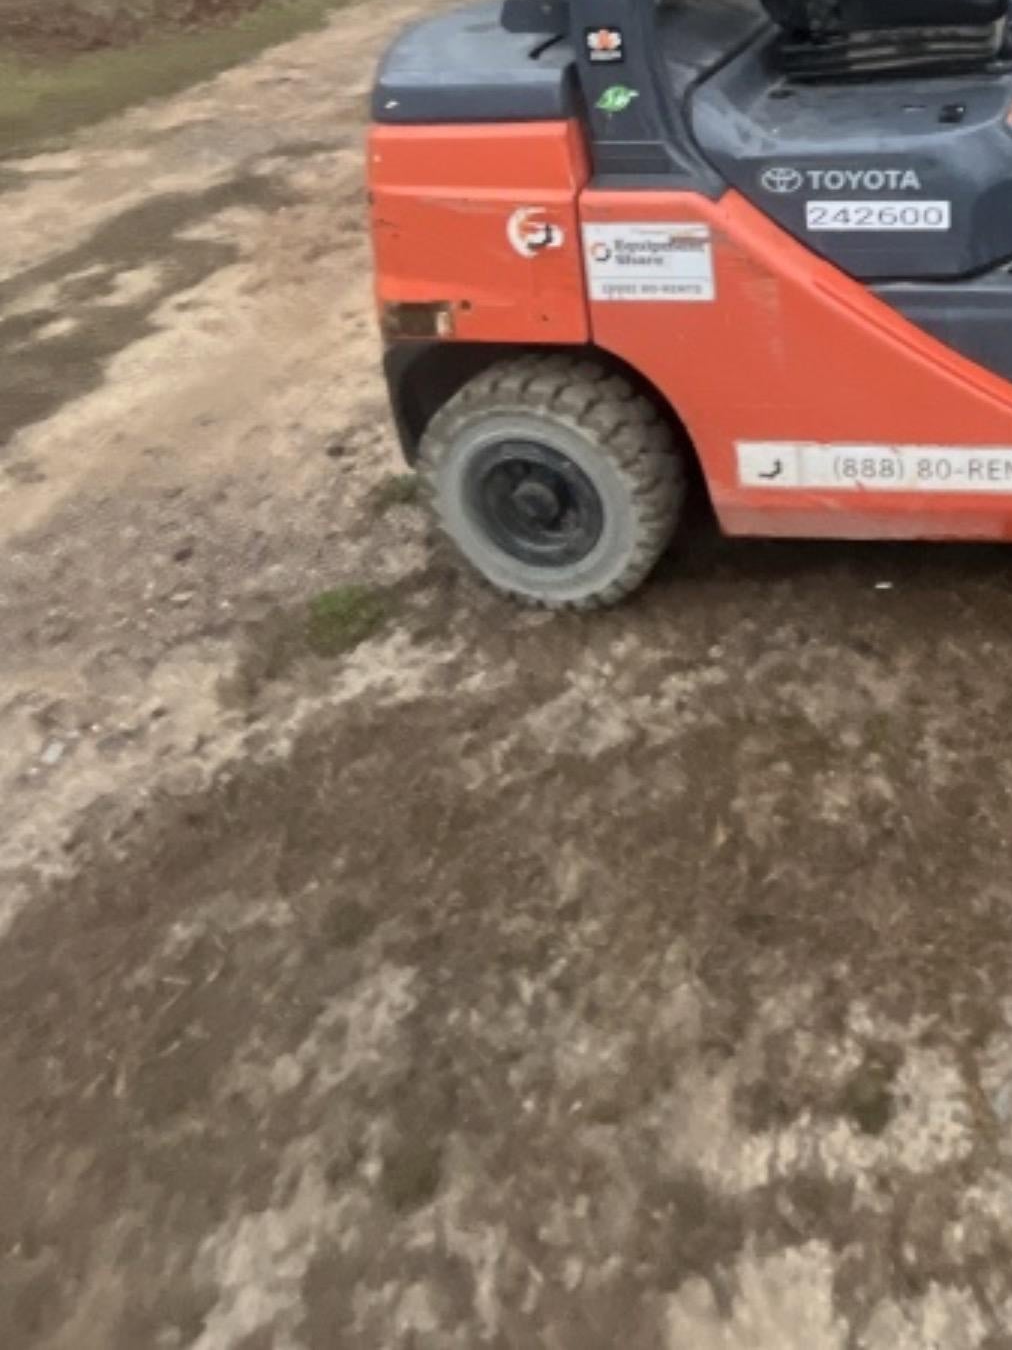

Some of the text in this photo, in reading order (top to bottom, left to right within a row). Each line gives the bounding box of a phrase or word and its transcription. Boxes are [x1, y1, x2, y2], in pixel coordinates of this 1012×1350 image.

[806, 169, 922, 190] TOYOTA
[808, 206, 944, 226] 242600
[833, 457, 905, 481] (888)
